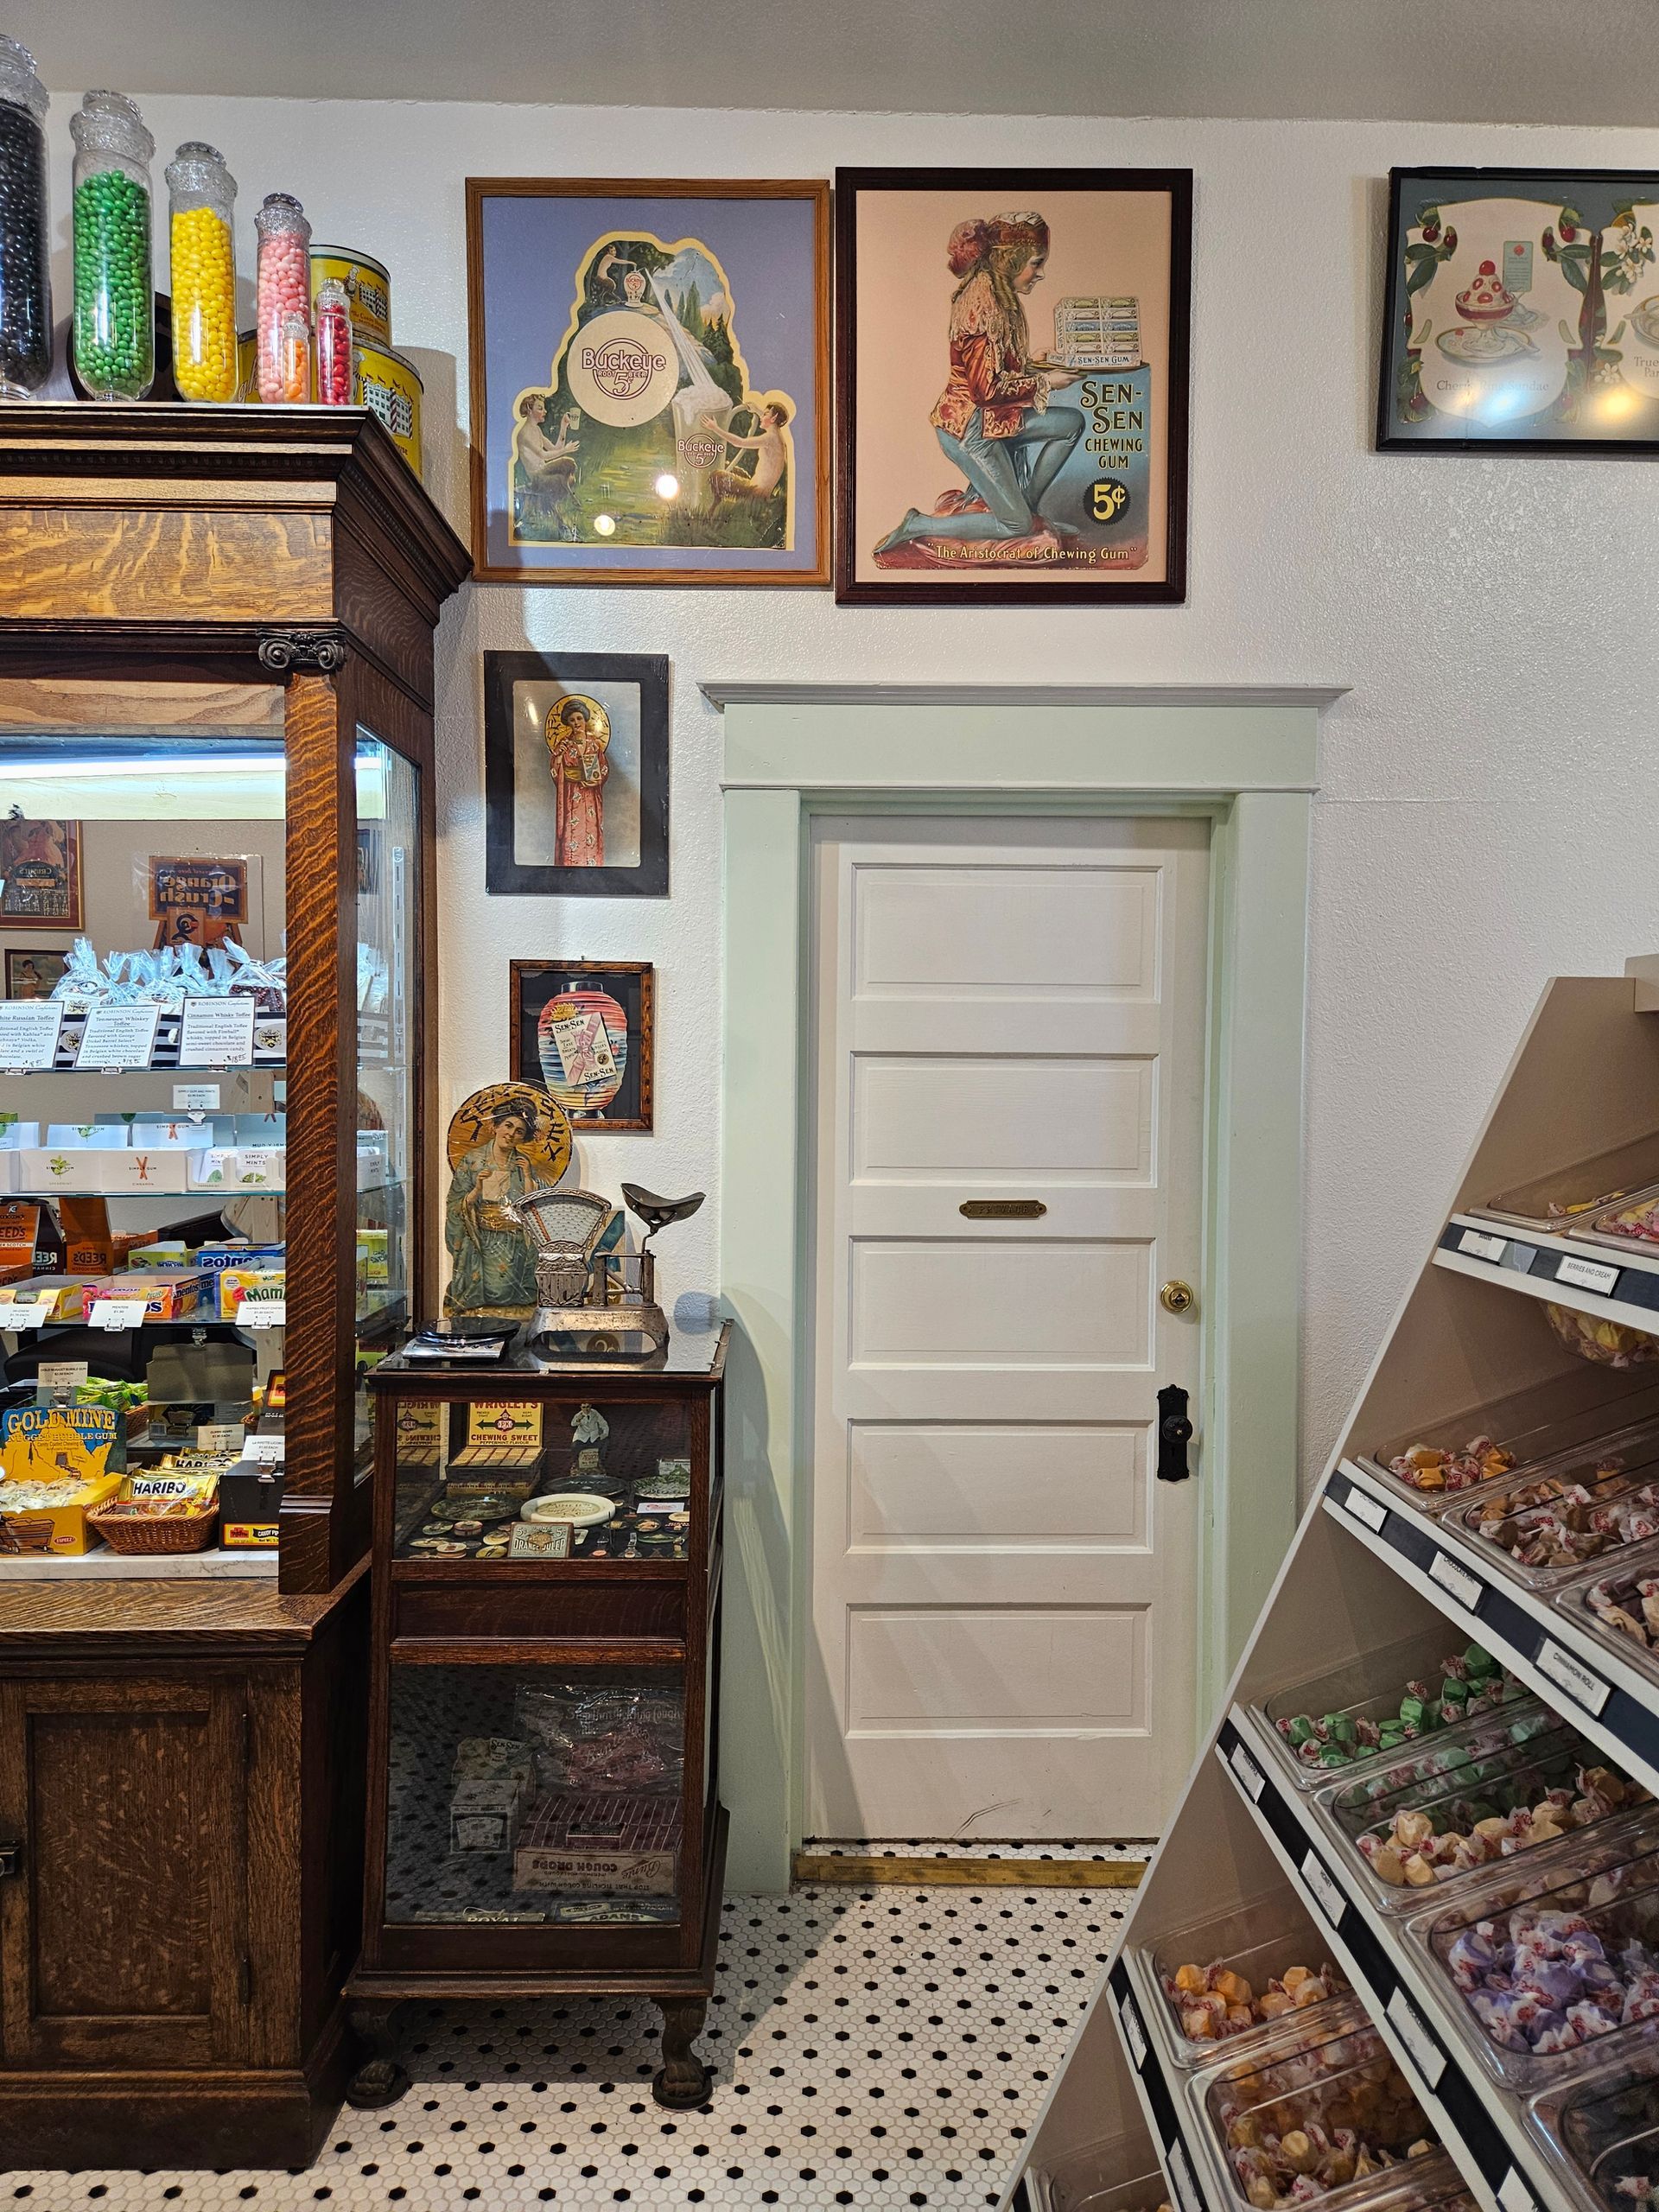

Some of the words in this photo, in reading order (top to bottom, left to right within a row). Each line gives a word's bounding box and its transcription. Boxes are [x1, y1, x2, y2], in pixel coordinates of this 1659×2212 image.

[582, 347, 666, 372] Buckeye
[1111, 355, 1129, 364] GUM
[1080, 380, 1142, 408] SEN-
[1092, 406, 1143, 434] SEN
[678, 439, 725, 454] Buckeye
[1085, 438, 1143, 452] CHEWING
[1098, 455, 1129, 468] GUM
[1093, 484, 1126, 520] 5¢
[960, 546, 1020, 559] Aristocrat
[1026, 546, 1039, 559] of
[1044, 547, 1096, 564] Chewing
[554, 1019, 585, 1034] SEN-SEN
[584, 1067, 614, 1081] SEN-SEN
[1567, 1262, 1586, 1273] BERRIES
[1586, 1266, 1595, 1275] AND
[1595, 1268, 1612, 1280] CREAM
[8, 1409, 60, 1434] GOLD
[65, 1408, 116, 1430] MINE
[8, 1433, 49, 1442] NUGGET
[53, 1432, 93, 1441] BUBBLE
[134, 1482, 187, 1495] HARIBO
[513, 1537, 540, 1551] ORANGE
[541, 1537, 566, 1551] JULEP
[1553, 1652, 1581, 1679] CINNAMON
[1580, 1671, 1596, 1691] ROLL
[532, 1860, 573, 1872] DROPS
[577, 1861, 618, 1872] COUGH
[621, 1859, 661, 1879] Bunte
